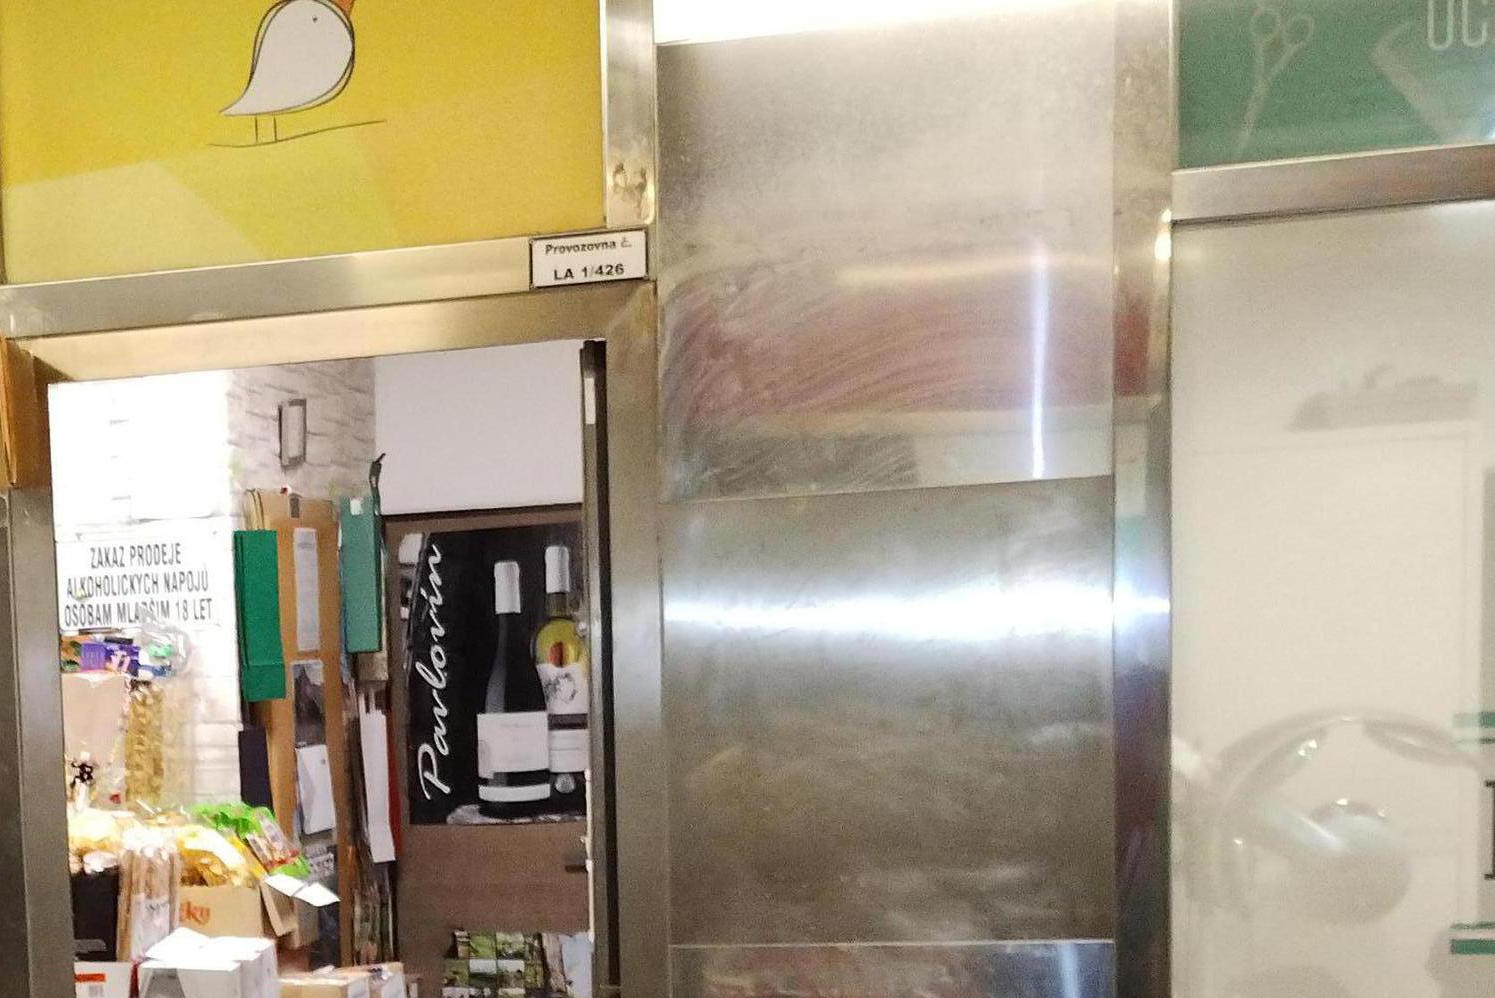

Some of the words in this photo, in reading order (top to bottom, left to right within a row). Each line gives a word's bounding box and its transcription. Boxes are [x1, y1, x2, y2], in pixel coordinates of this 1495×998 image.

[545, 240, 617, 255] Provozovna
[553, 268, 575, 281] LA
[129, 542, 182, 567] PRODEJE
[175, 598, 190, 621] 18
[193, 597, 213, 621] LET
